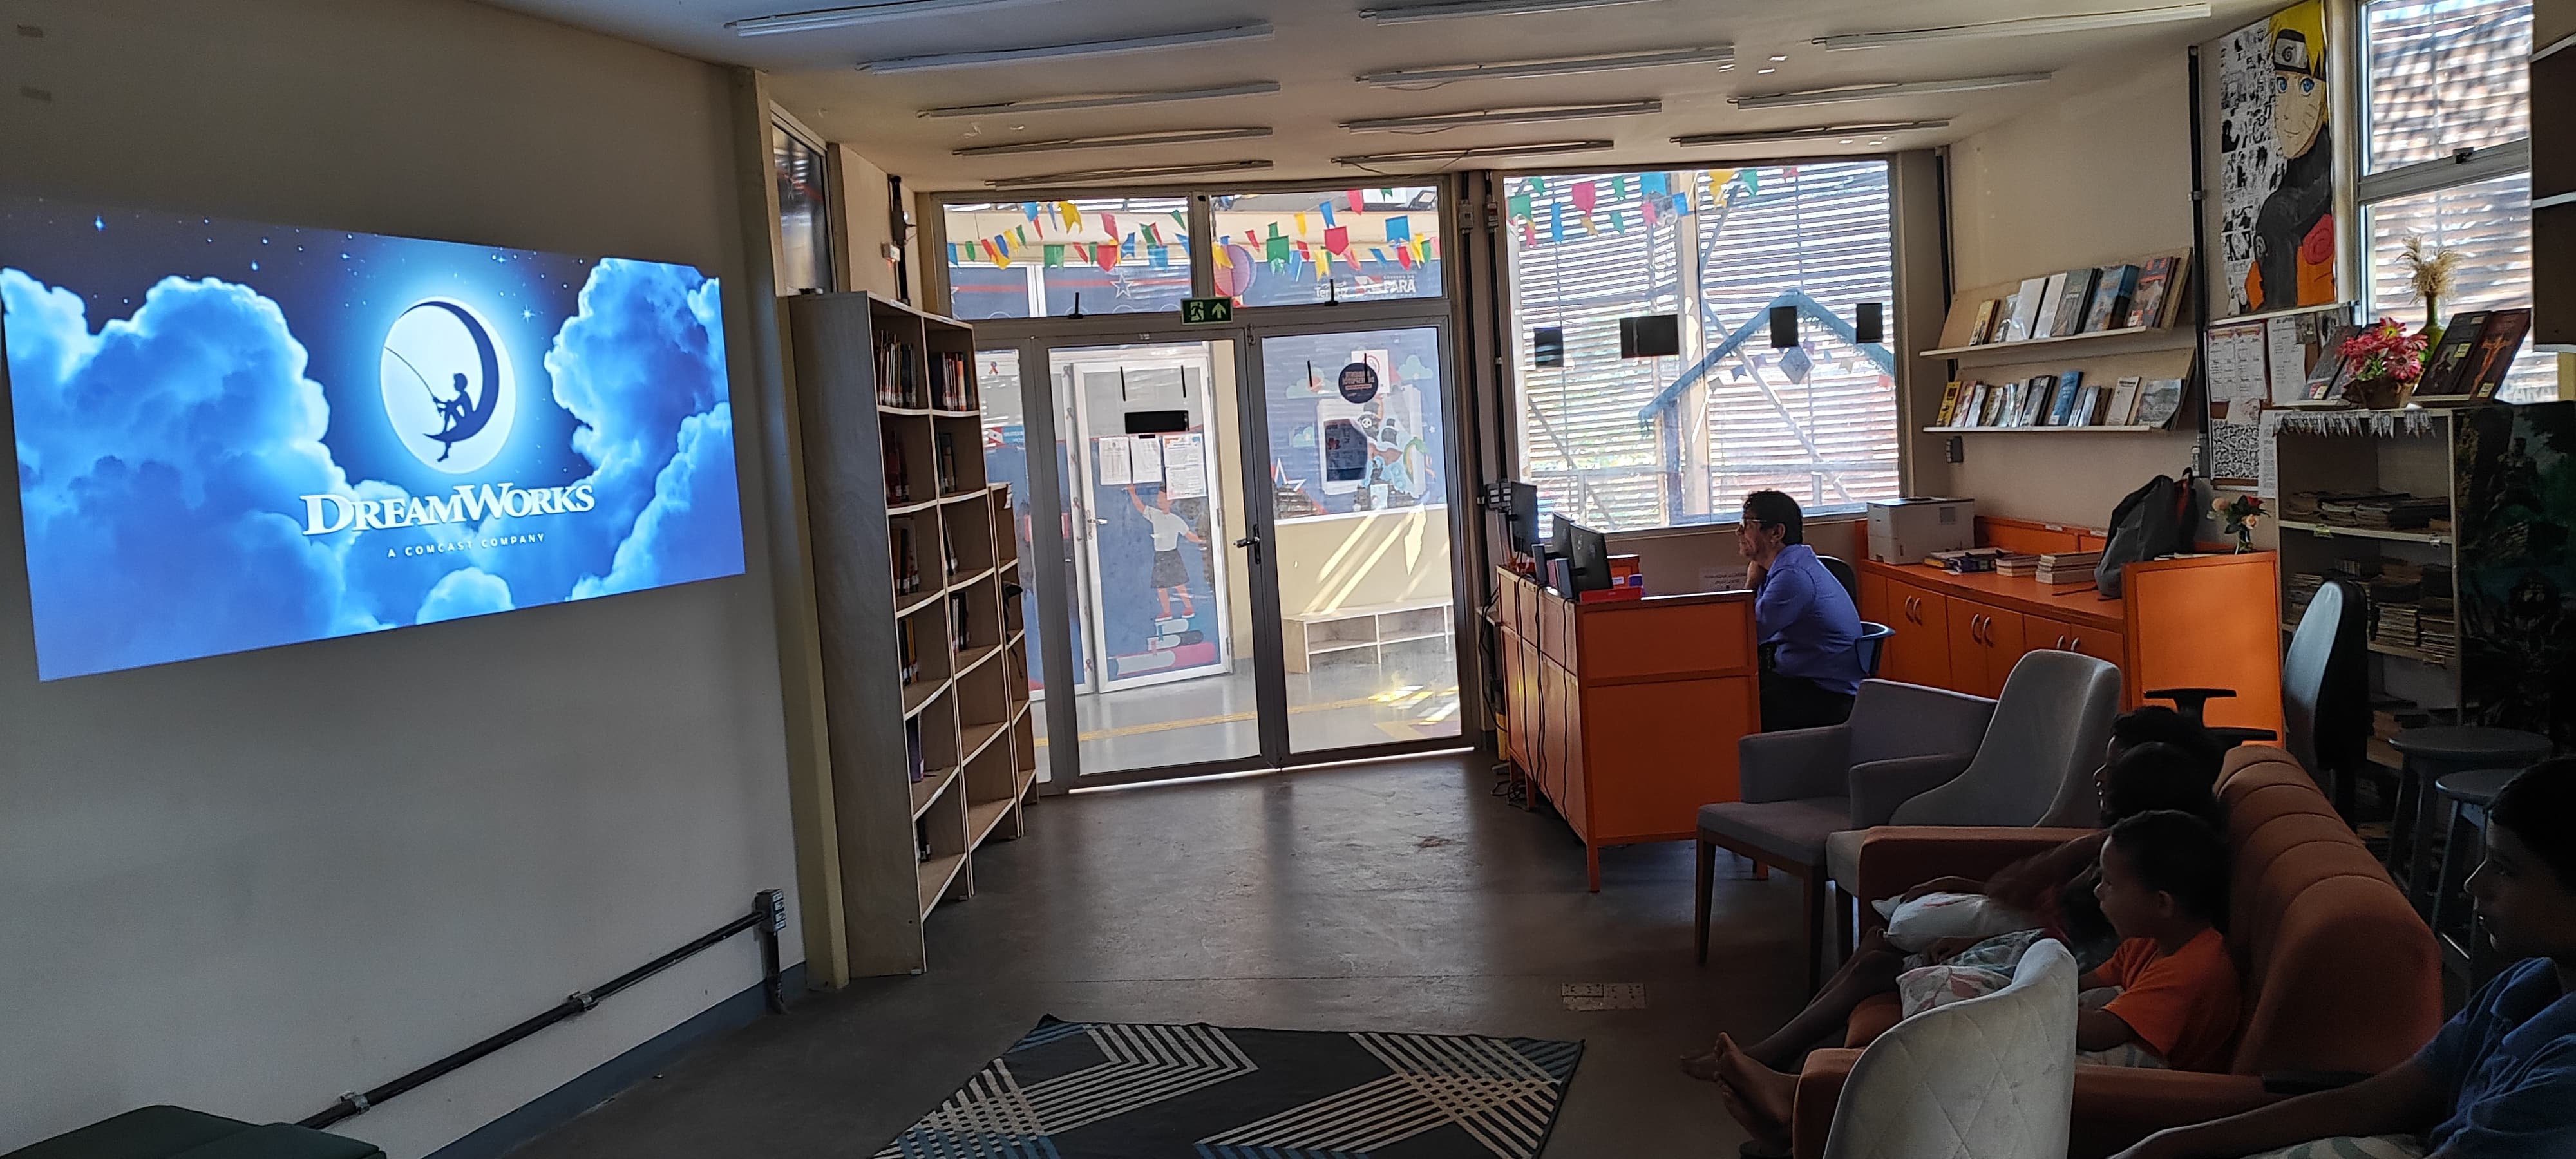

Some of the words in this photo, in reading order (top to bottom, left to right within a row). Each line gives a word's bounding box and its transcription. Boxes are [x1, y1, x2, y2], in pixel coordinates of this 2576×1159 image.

[388, 548, 396, 558] A
[404, 540, 473, 556] COMCAST
[481, 533, 545, 548] COMPANY
